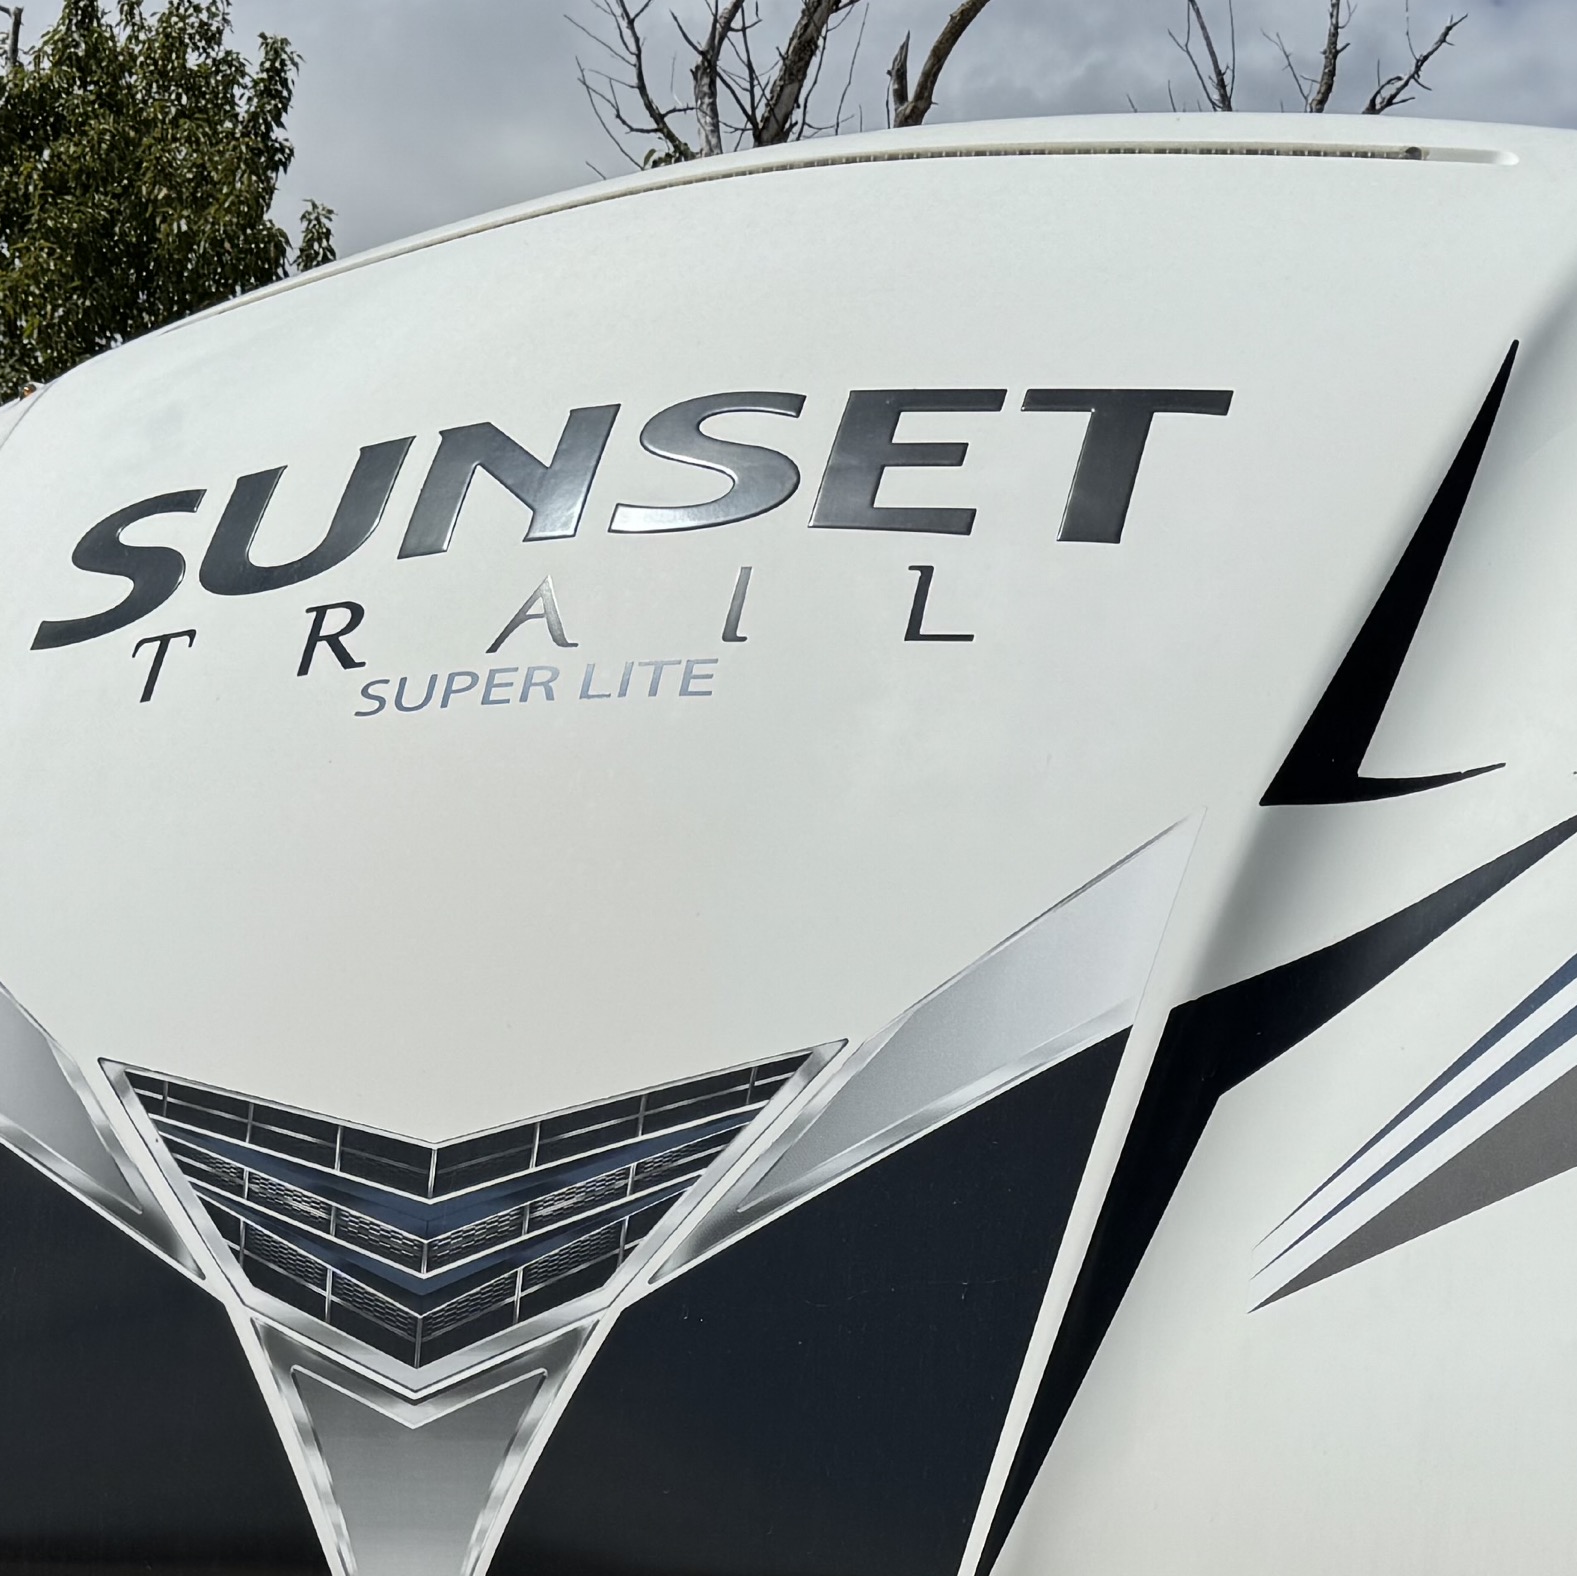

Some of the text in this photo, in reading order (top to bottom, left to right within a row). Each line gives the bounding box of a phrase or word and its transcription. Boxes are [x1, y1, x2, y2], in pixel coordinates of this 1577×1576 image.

[30, 388, 1234, 653] SUNSET
[131, 564, 976, 704] TRAIL
[353, 657, 720, 719] SUPER LITE
